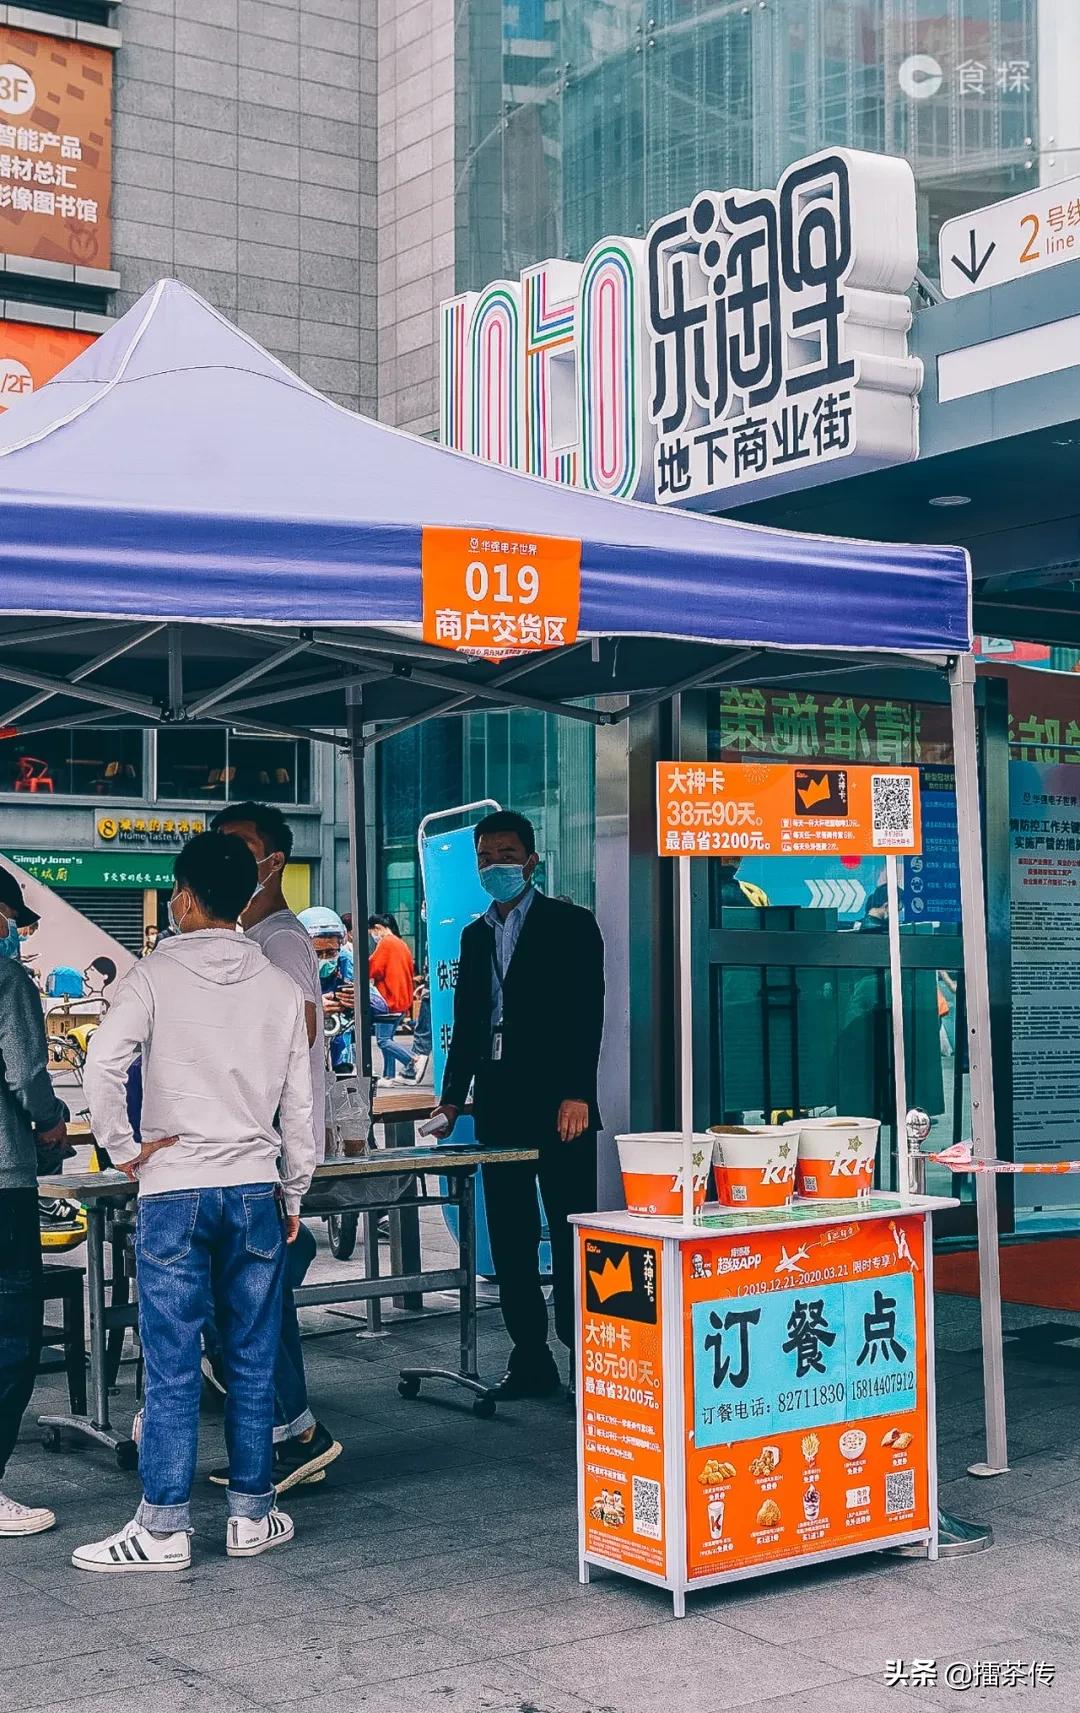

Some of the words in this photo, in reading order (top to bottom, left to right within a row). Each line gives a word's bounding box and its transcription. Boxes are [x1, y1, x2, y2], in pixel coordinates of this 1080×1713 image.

[0, 76, 28, 102] 3F
[0, 124, 82, 160] 智能产品
[1046, 235, 1075, 255] line
[657, 389, 854, 496] 地下商业街
[465, 561, 540, 605] 019
[434, 608, 568, 647] 商户交货区
[667, 767, 725, 794] 大神卡
[716, 1253, 762, 1276] 超级APP
[585, 1320, 632, 1353] 大神卡
[778, 1382, 845, 1413] 82711830
[851, 1370, 915, 1401] 15814407912
